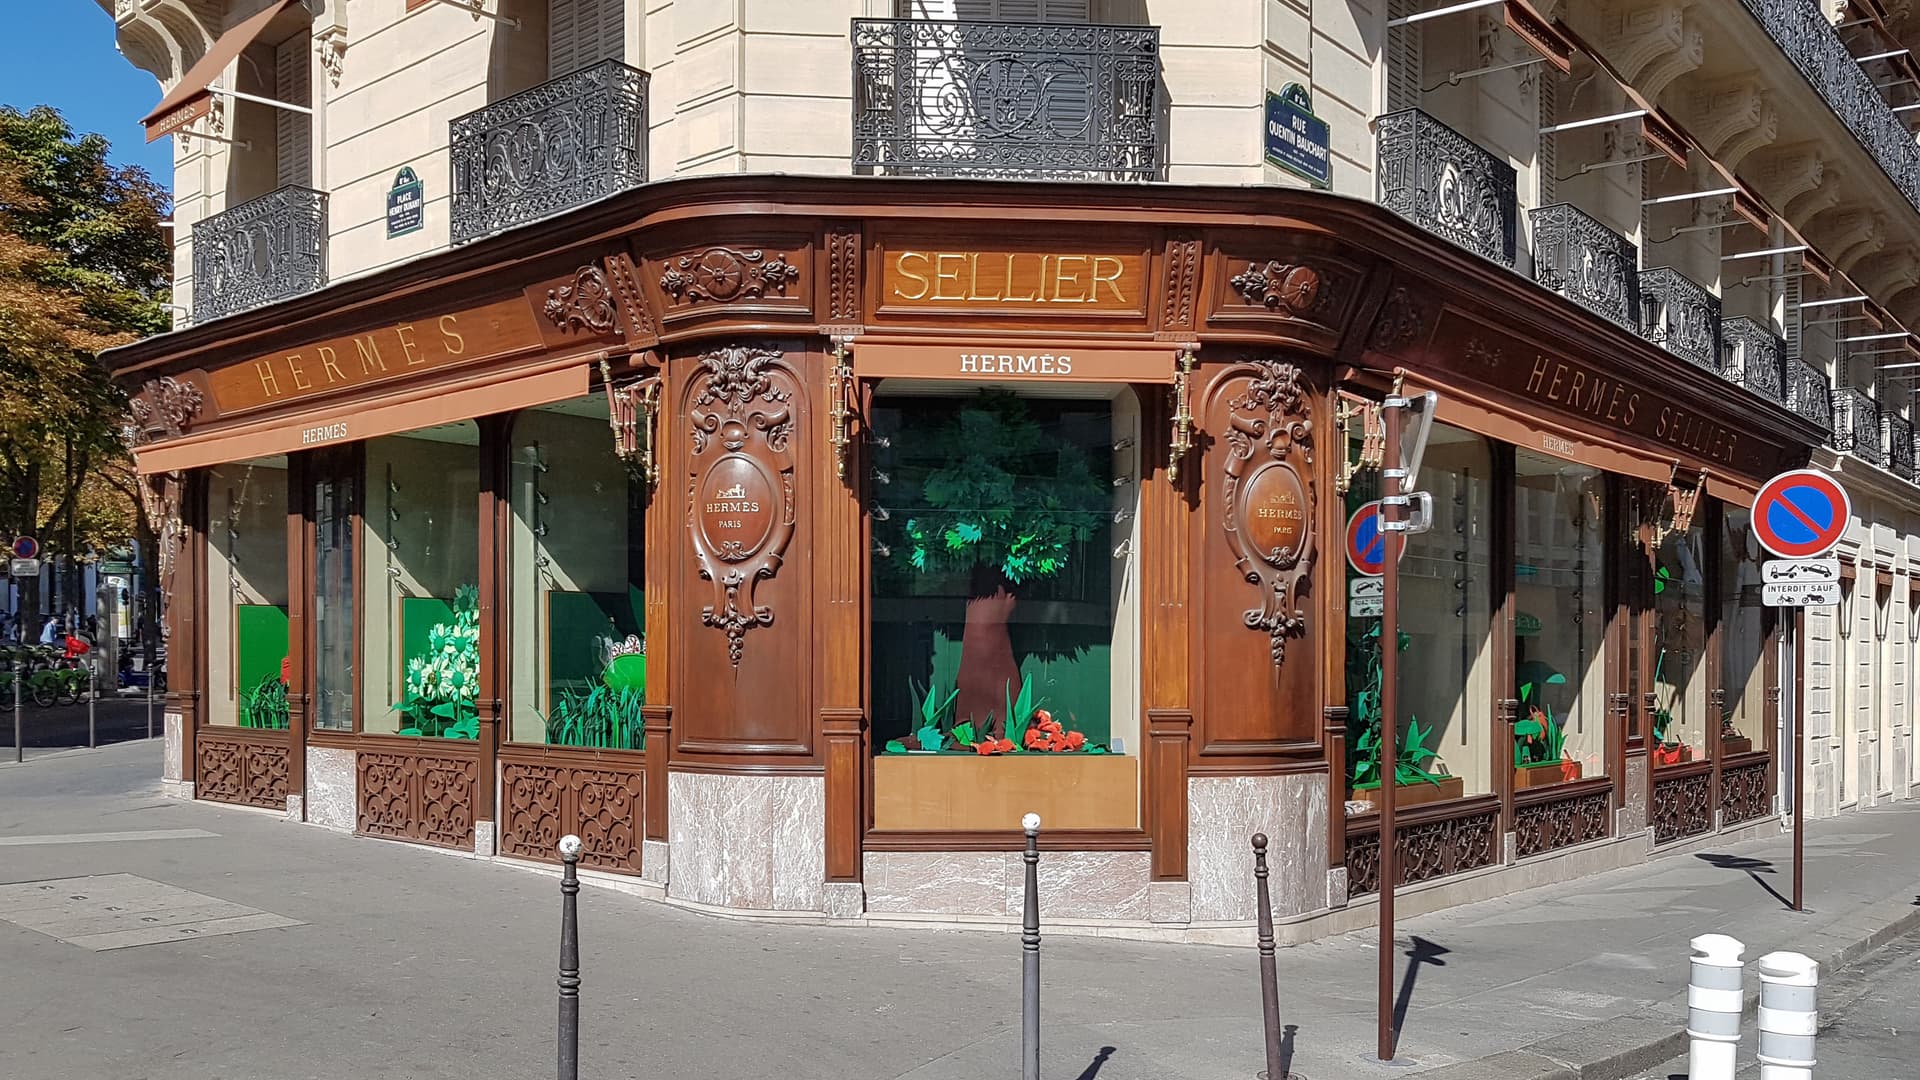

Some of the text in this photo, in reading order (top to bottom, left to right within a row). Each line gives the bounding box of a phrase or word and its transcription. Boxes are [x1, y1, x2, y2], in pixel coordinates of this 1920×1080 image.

[1292, 115, 1307, 134] RUE
[1269, 120, 1296, 145] QUENTIN
[1296, 134, 1327, 162] BAUCHART
[397, 191, 412, 204] PLACE
[893, 251, 1127, 303] SELLIER
[255, 314, 465, 397] HERMÈS
[1525, 354, 1737, 463] HERMÈS SELLIER
[718, 520, 742, 528] PARIS
[1767, 584, 1834, 593] INTERDIT SAUF
